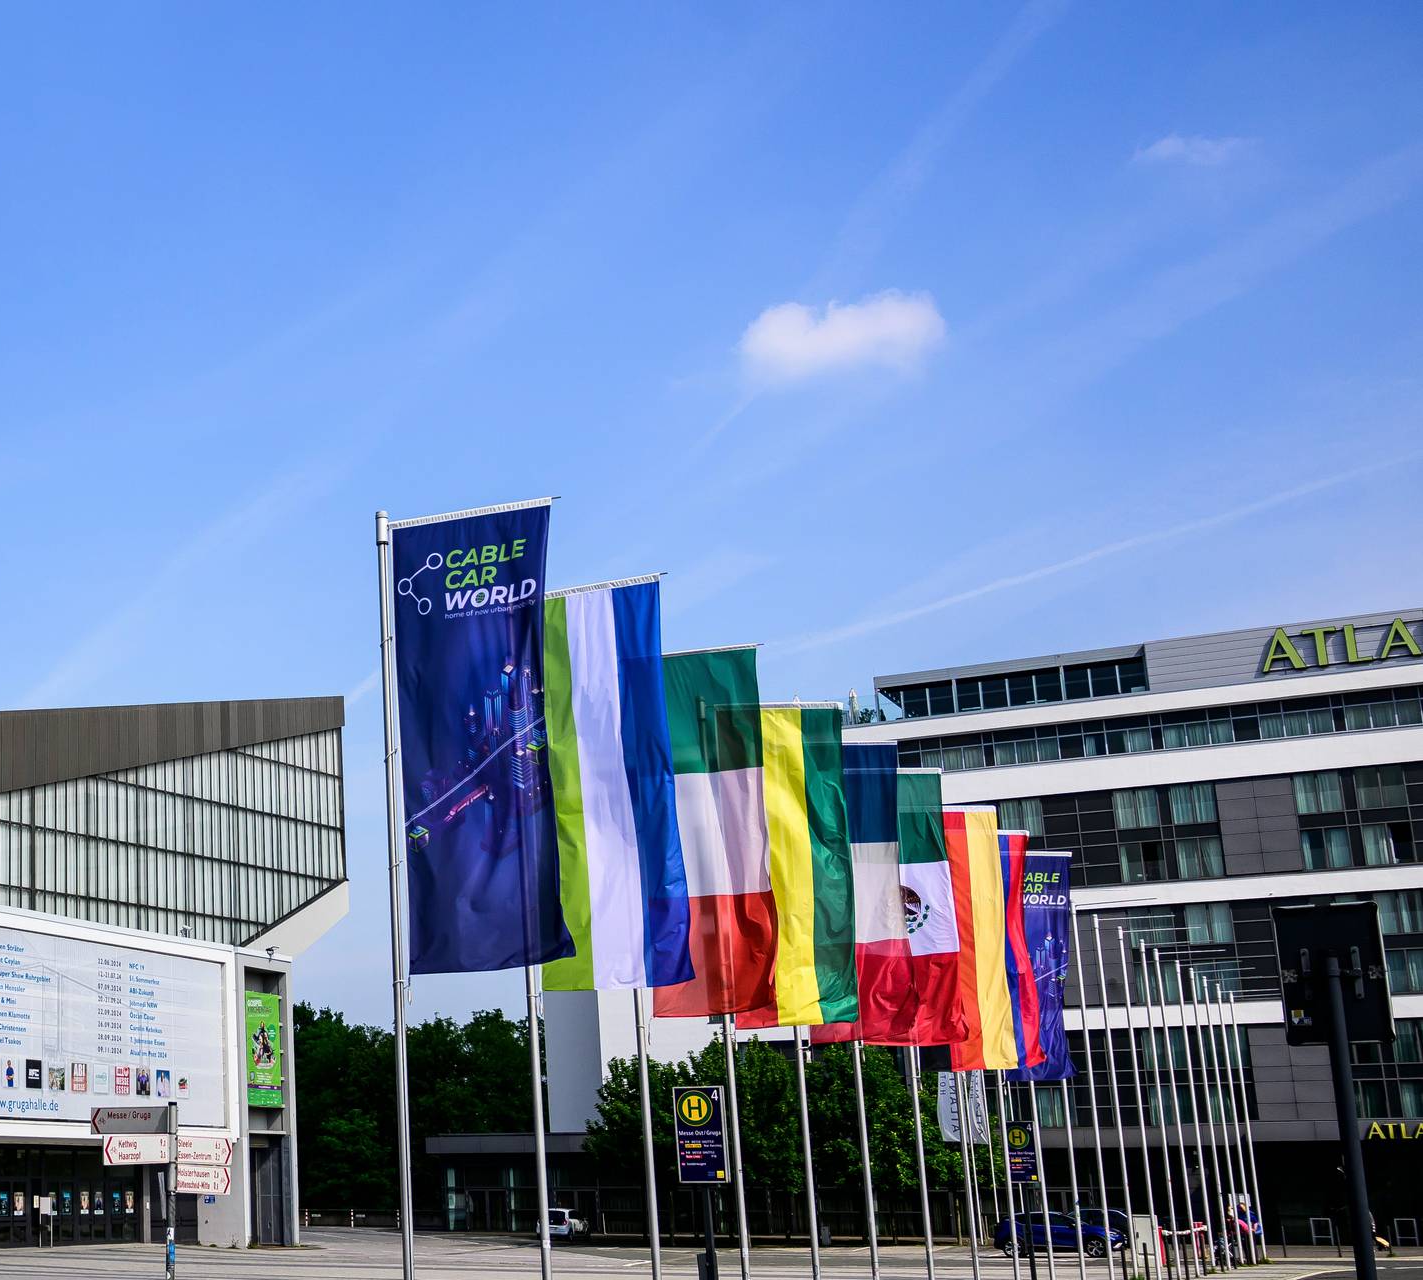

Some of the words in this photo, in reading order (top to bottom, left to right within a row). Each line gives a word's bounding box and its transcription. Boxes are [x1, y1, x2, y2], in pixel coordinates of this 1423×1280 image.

[446, 539, 526, 568] CABLE
[445, 566, 497, 589] CAR
[444, 578, 536, 611] WORLD
[1262, 618, 1423, 673] ATLA
[1024, 872, 1060, 882] ABLE
[1024, 883, 1044, 894] AR
[7, 944, 24, 952] Sträter
[25, 973, 51, 983] Ruhrgebiet
[8, 1011, 30, 1020] Klamotte
[98, 1008, 121, 1017] 22.09.2024
[98, 1020, 121, 1029] 26.09.2024
[5, 1037, 21, 1045] Tsokos
[98, 1033, 121, 1042] 28.09.2024
[98, 1046, 121, 1054] 09.11.2024
[74, 1064, 85, 1077] ABI
[711, 1089, 718, 1101] 4
[107, 1112, 127, 1120] Messe
[132, 1111, 151, 1120] Gruga
[118, 1139, 137, 1149] Kettwig
[178, 1139, 192, 1148] Steele
[118, 1151, 141, 1161] Haarzopf
[178, 1150, 211, 1160] Essen-Zentrum
[177, 1168, 210, 1177] Holsterhausen
